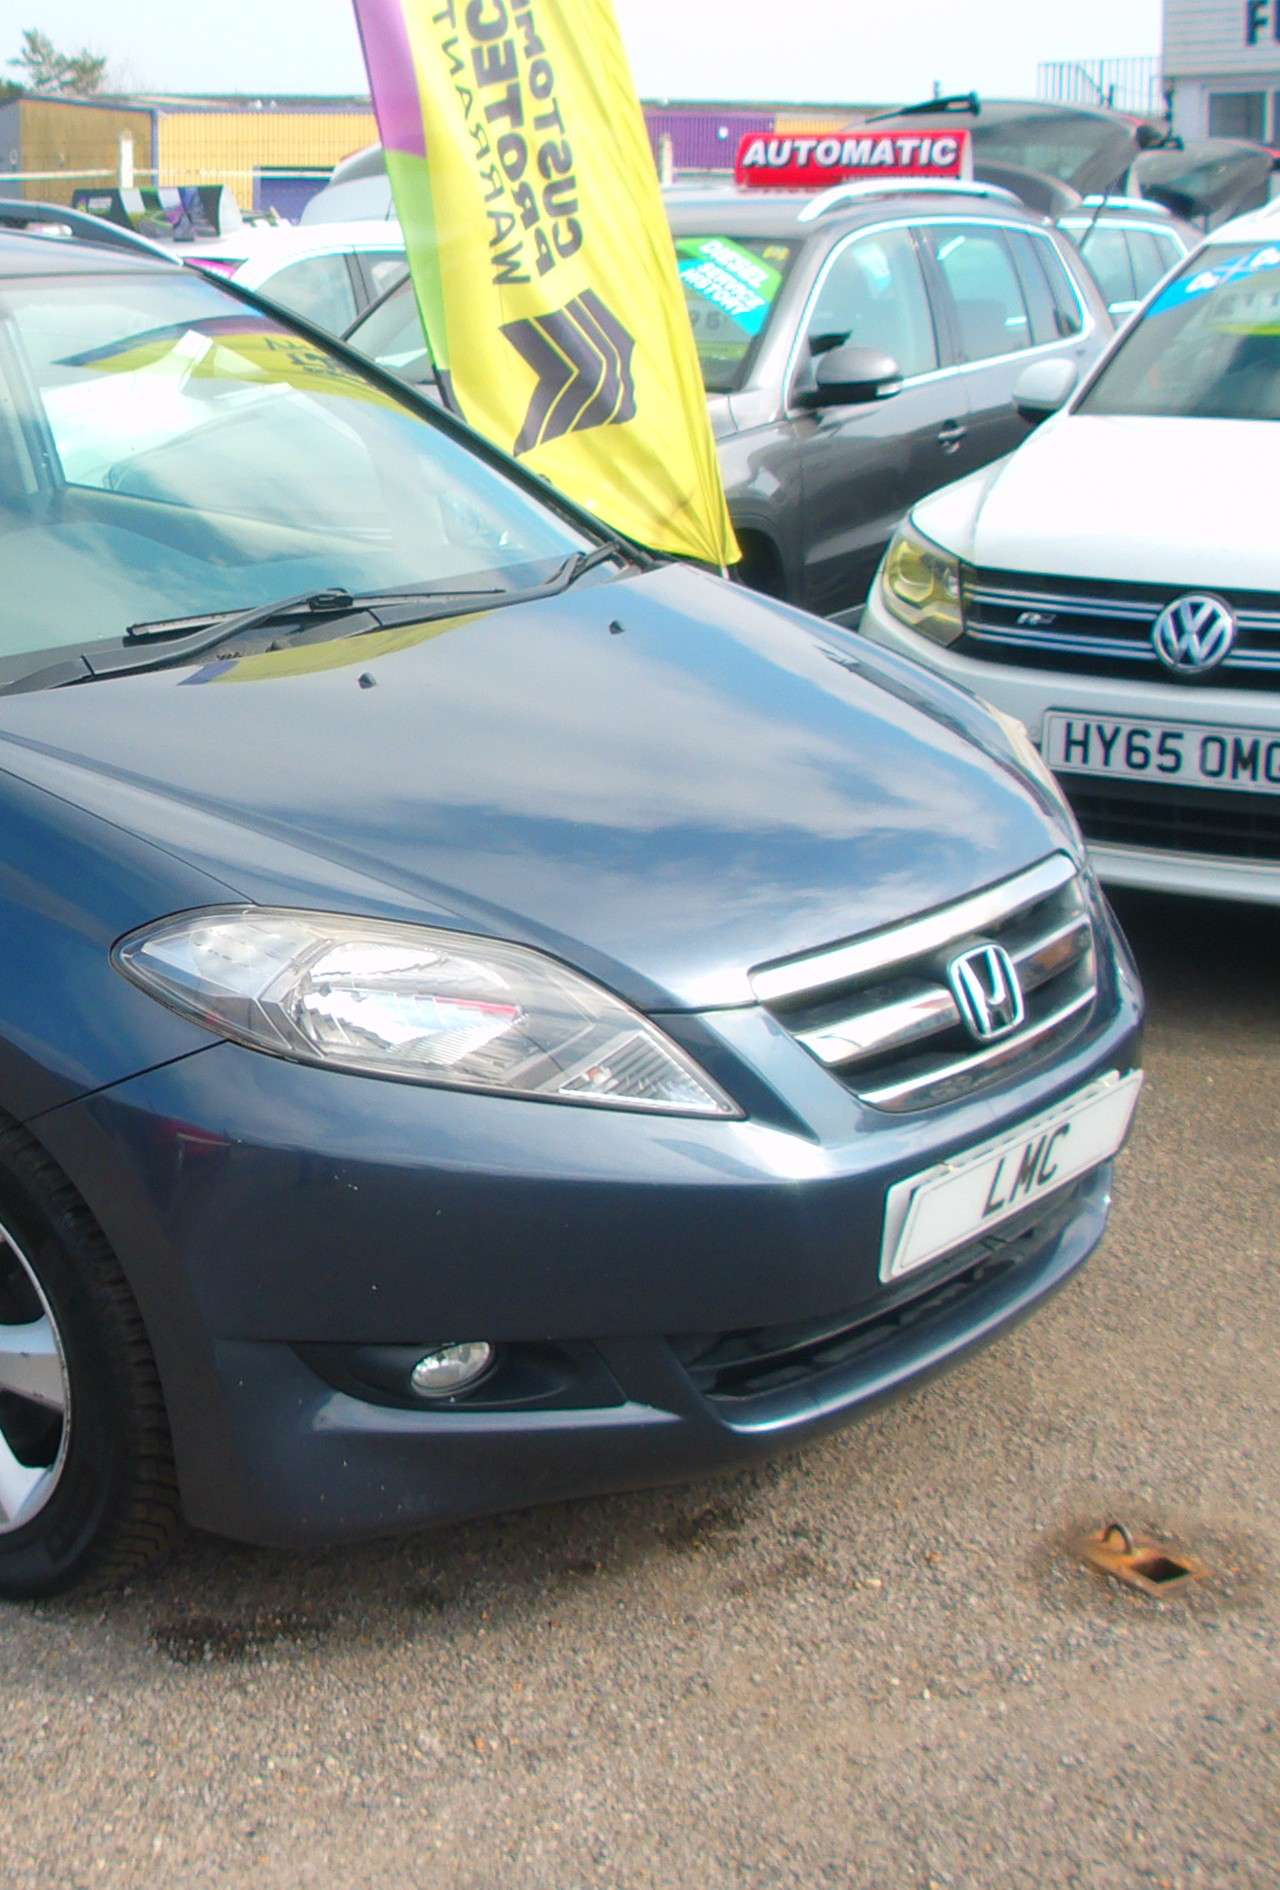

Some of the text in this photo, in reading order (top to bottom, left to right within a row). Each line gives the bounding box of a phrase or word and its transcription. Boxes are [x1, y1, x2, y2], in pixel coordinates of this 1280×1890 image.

[742, 137, 960, 168] AUTOMATIC
[1064, 721, 1185, 774] HY65
[982, 1122, 1071, 1219] LMC
